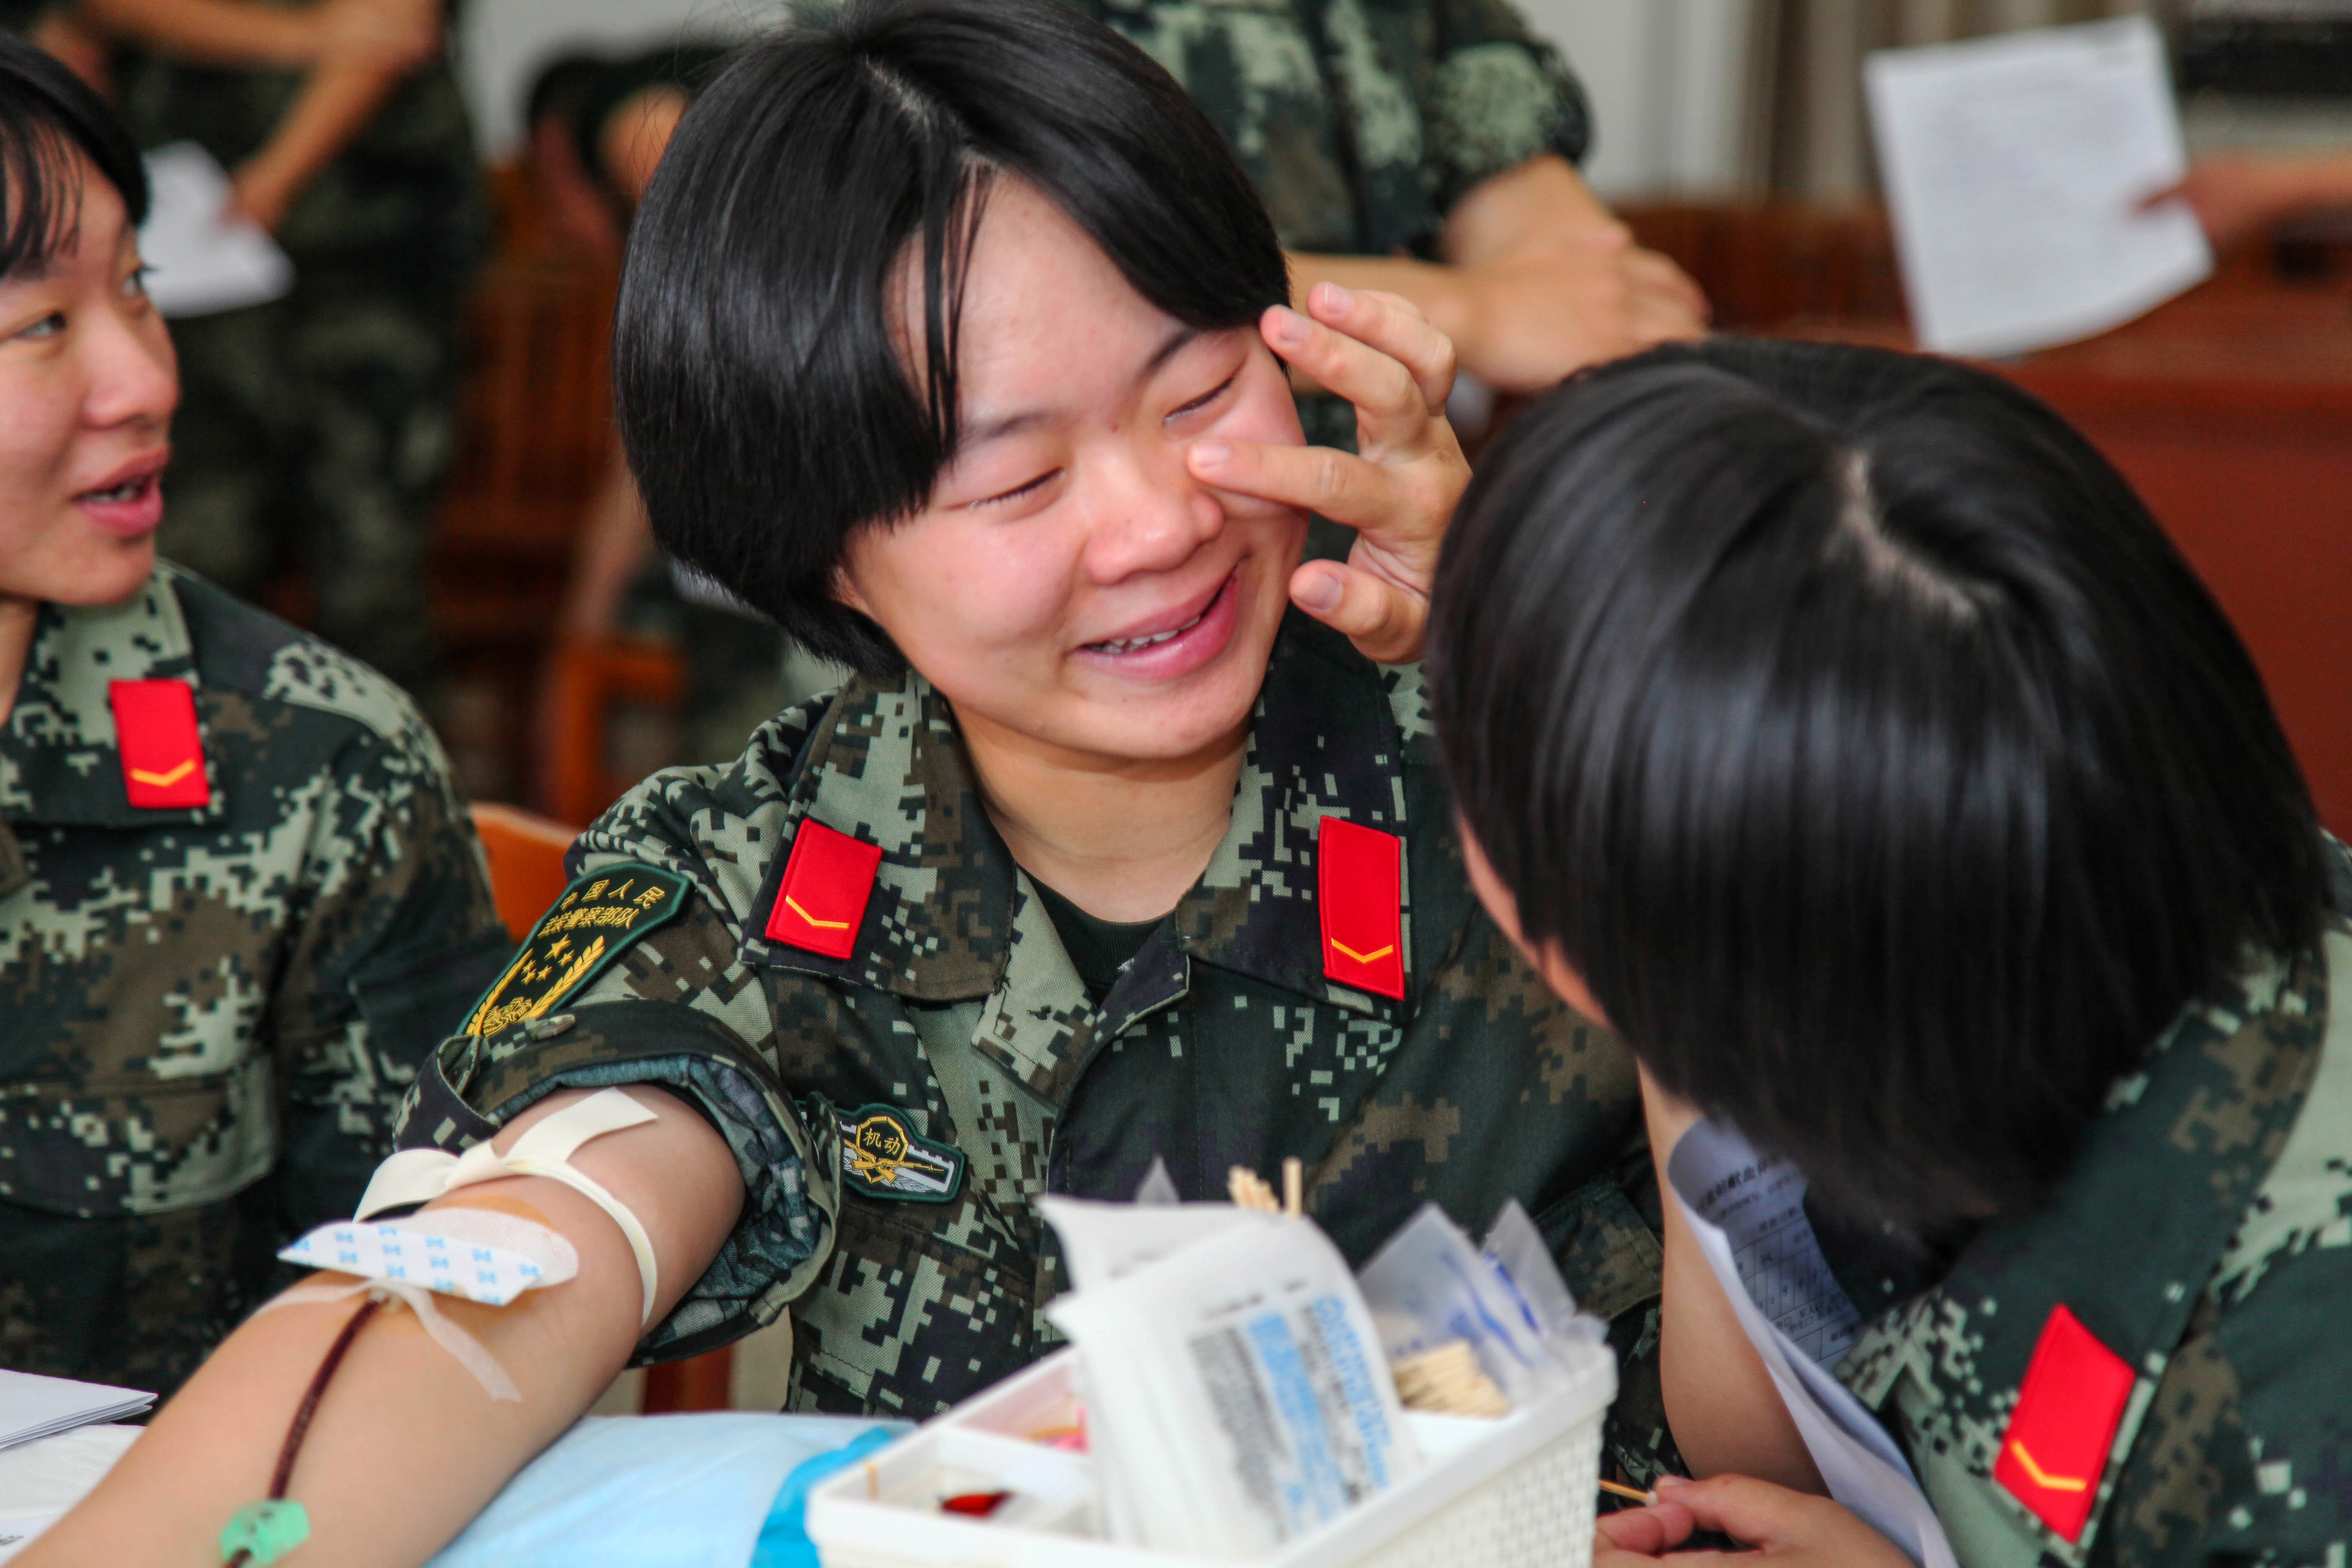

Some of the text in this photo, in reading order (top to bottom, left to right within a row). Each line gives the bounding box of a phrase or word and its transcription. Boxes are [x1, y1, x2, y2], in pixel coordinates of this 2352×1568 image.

[560, 879, 666, 910] 中国人民
[537, 906, 640, 939] 武装警察部队
[863, 1128, 901, 1155] 机动
